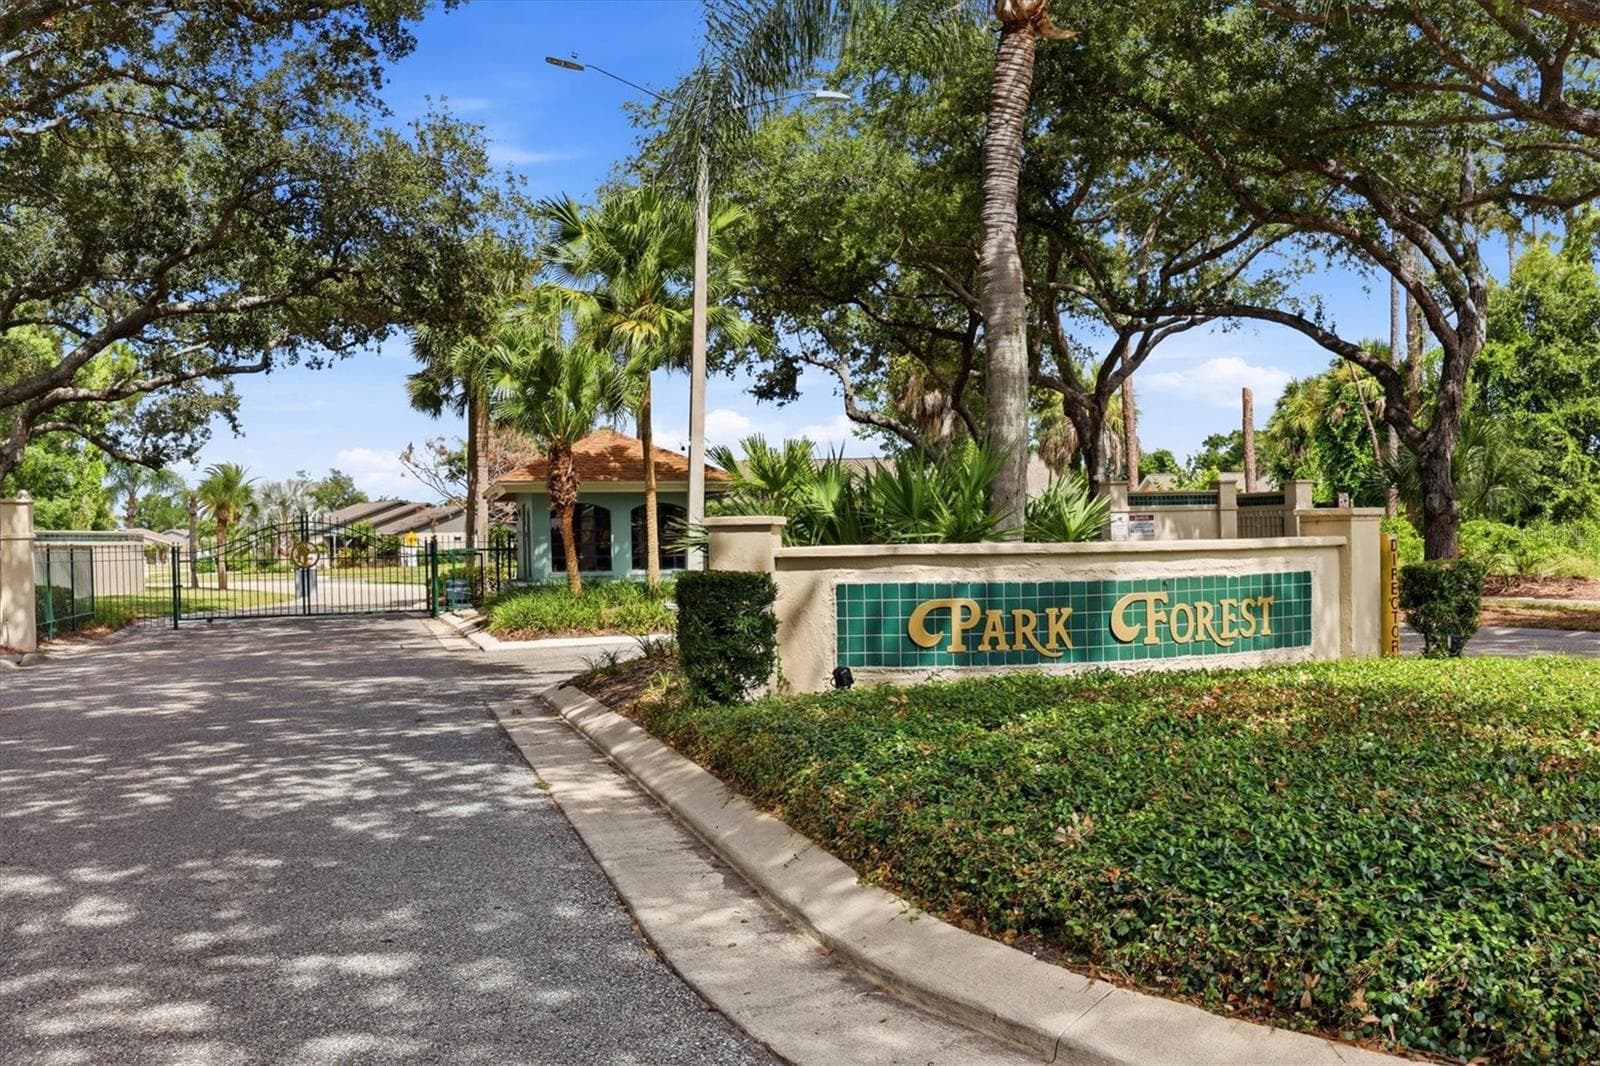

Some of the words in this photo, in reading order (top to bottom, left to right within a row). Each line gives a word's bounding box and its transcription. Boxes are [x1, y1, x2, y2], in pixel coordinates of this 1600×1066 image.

[908, 598, 1073, 657] PARK
[1110, 591, 1274, 647] FOREST
[1390, 539, 1399, 655] DIRECTOR
